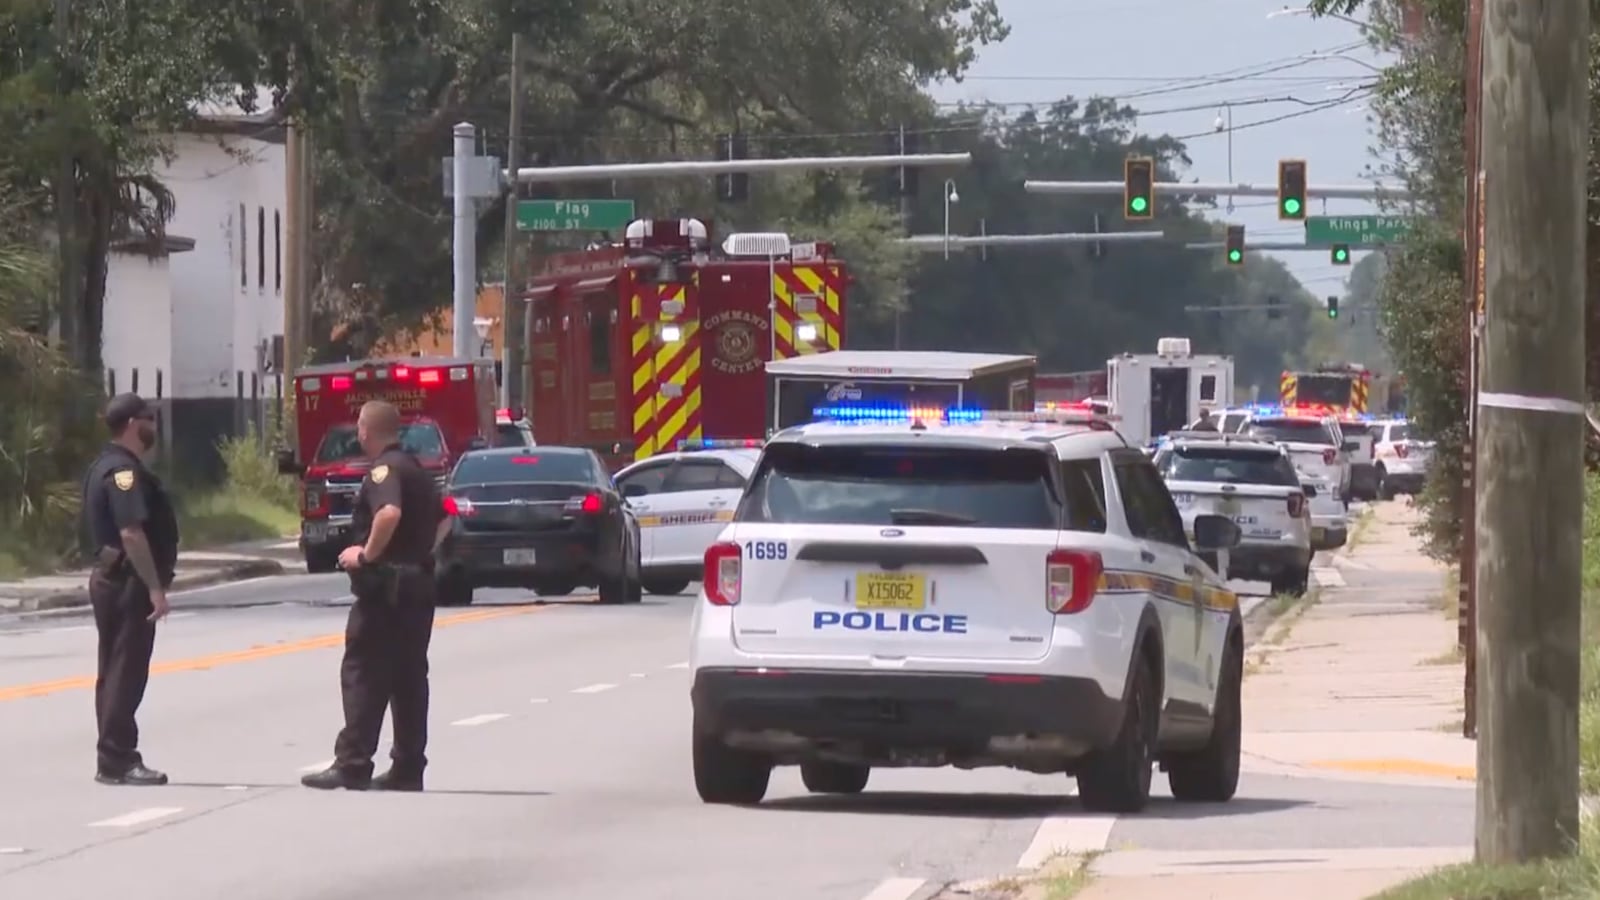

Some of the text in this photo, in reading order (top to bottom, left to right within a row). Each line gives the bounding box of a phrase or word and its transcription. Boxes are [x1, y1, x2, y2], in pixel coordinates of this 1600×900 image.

[555, 201, 590, 218] Flag
[1329, 218, 1369, 232] Kings
[704, 310, 768, 330] COMMAND
[712, 358, 763, 374] CENTER
[304, 394, 319, 411] 17
[745, 541, 788, 560] 1699
[813, 611, 968, 634] POLICE
